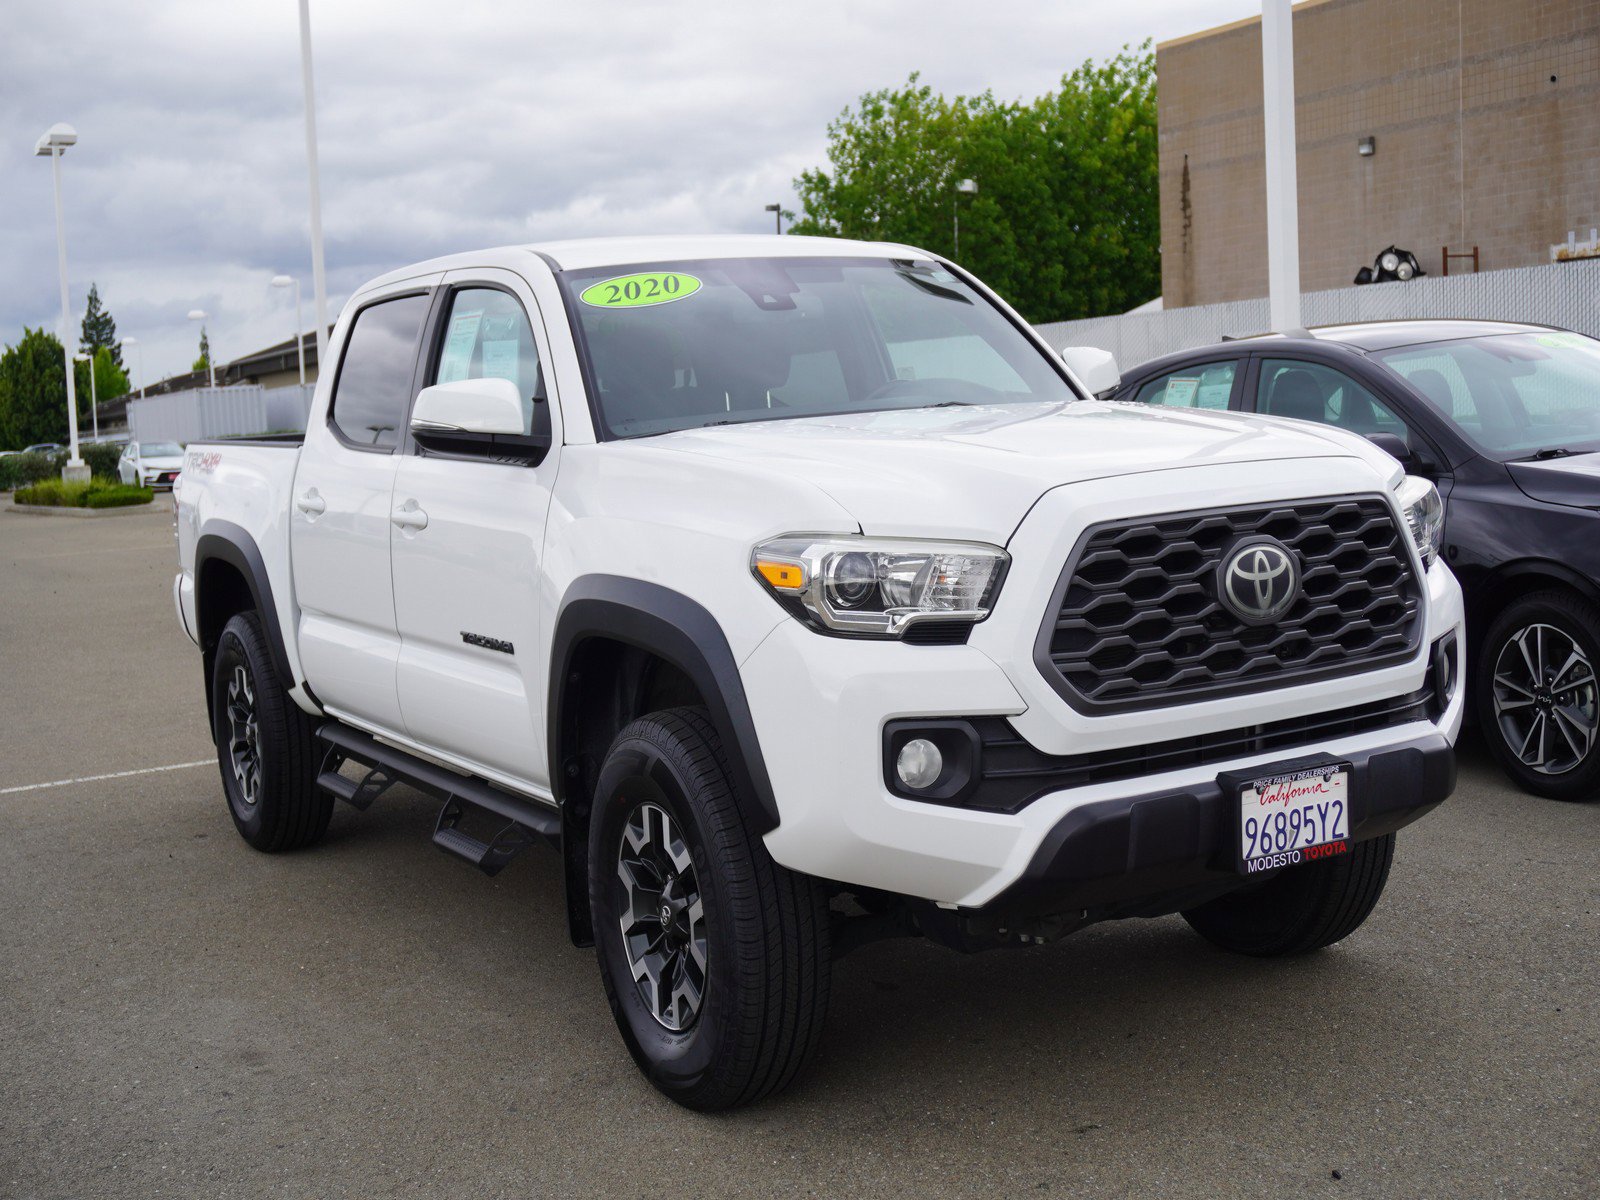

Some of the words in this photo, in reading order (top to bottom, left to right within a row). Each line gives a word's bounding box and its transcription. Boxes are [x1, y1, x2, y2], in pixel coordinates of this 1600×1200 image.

[604, 274, 680, 304] 2020
[460, 630, 515, 655] TACOMA
[1253, 779, 1272, 789] PRICE
[1274, 773, 1296, 785] FAMILY
[1297, 765, 1340, 781] DEALERSHIPS
[1260, 780, 1330, 808] California
[1245, 800, 1344, 860] 96895Y2
[1247, 850, 1300, 873] MODESTO
[1303, 840, 1347, 860] TOYOTA
